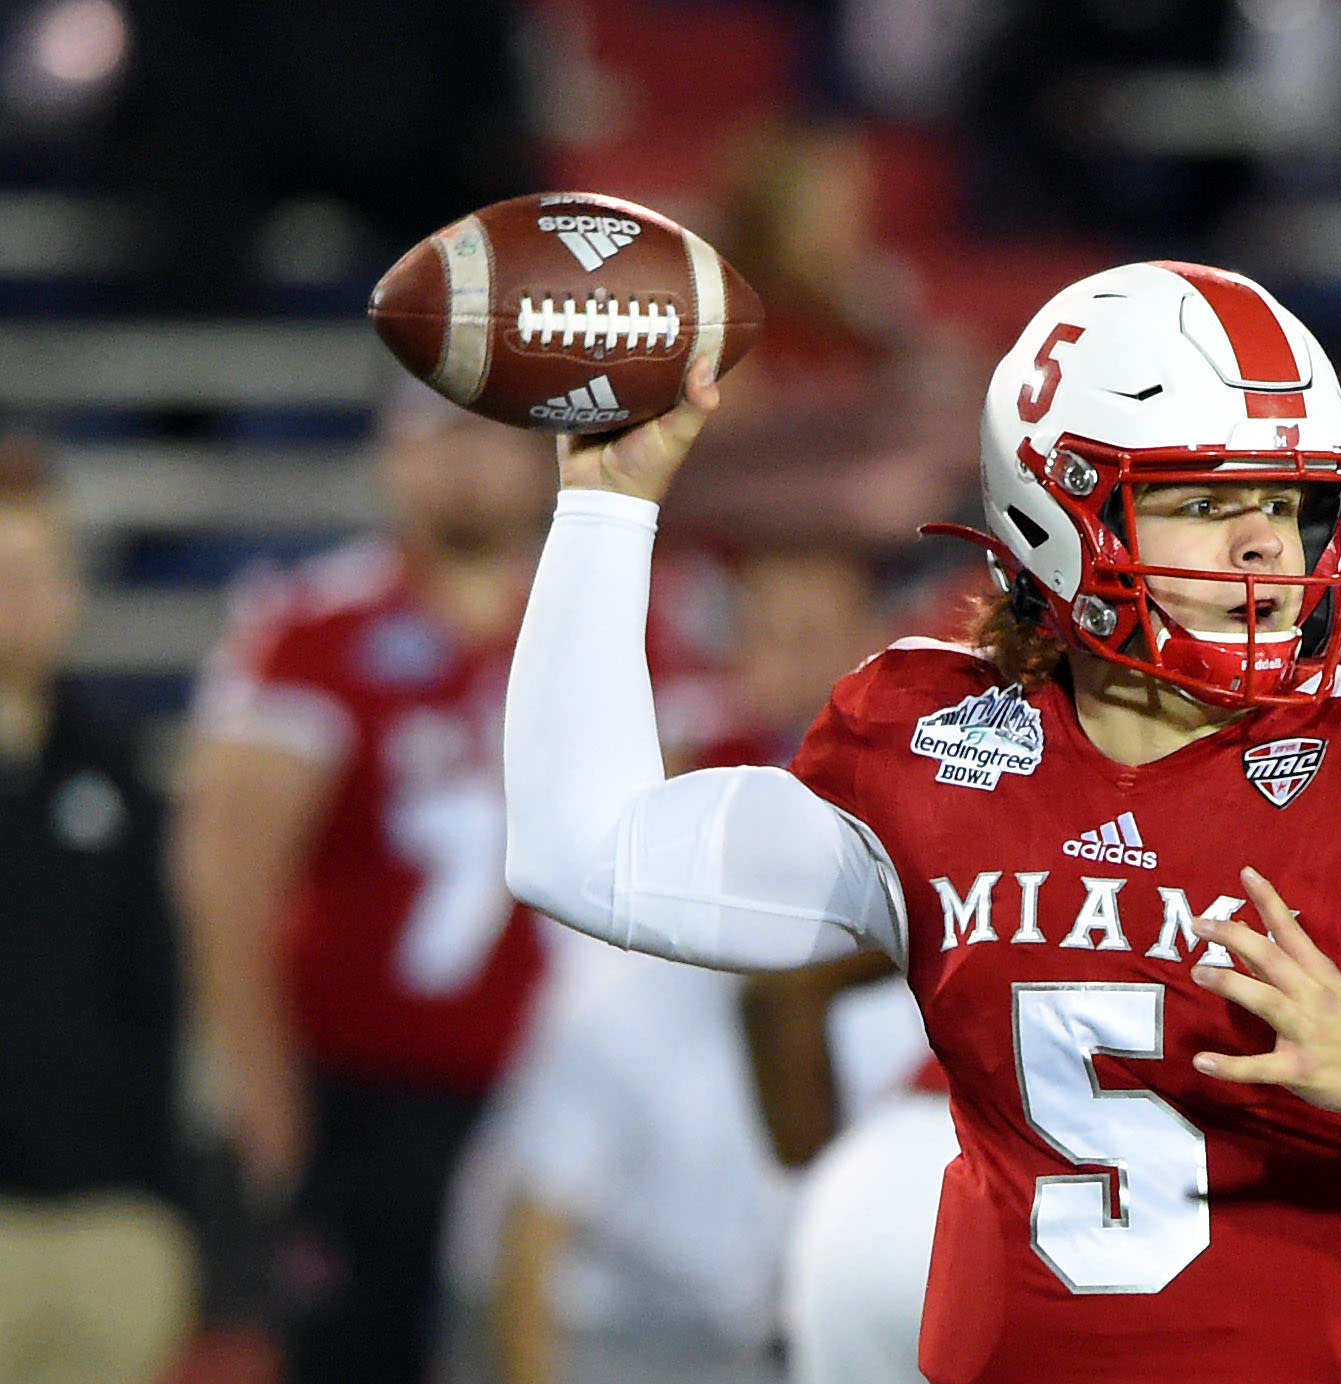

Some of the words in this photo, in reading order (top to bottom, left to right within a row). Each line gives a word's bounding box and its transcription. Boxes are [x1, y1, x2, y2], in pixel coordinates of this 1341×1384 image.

[537, 215, 642, 236] adidas
[1016, 322, 1086, 424] 5
[529, 404, 631, 422] adidas
[914, 728, 1037, 771] lendingtree
[940, 764, 994, 787] BOWL
[1246, 752, 1320, 780] MAC
[1062, 840, 1158, 870] adidas
[929, 871, 1300, 968] MIAM
[1010, 981, 1211, 1295] 5
